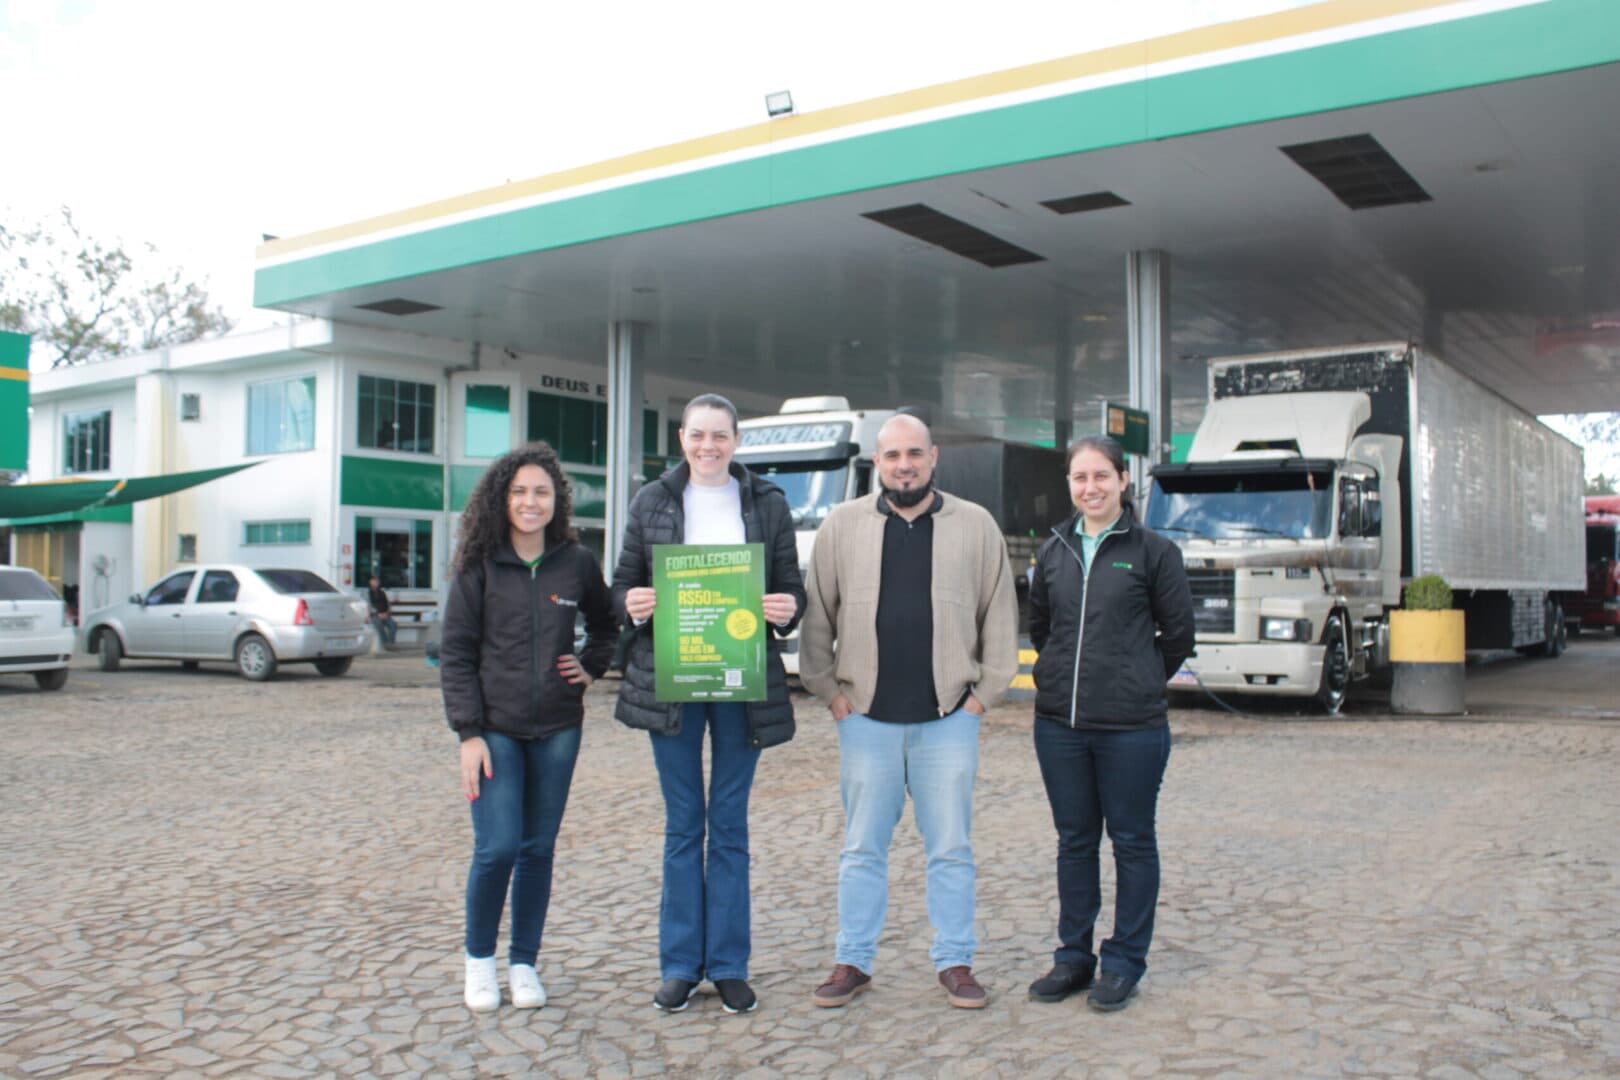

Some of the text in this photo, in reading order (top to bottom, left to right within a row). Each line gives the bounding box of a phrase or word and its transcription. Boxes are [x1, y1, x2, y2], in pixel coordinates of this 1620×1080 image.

[541, 374, 590, 393] DEUS
[738, 423, 844, 448] ORDEIRO
[665, 550, 752, 571] FORTALECENDO
[678, 590, 711, 605] R$50
